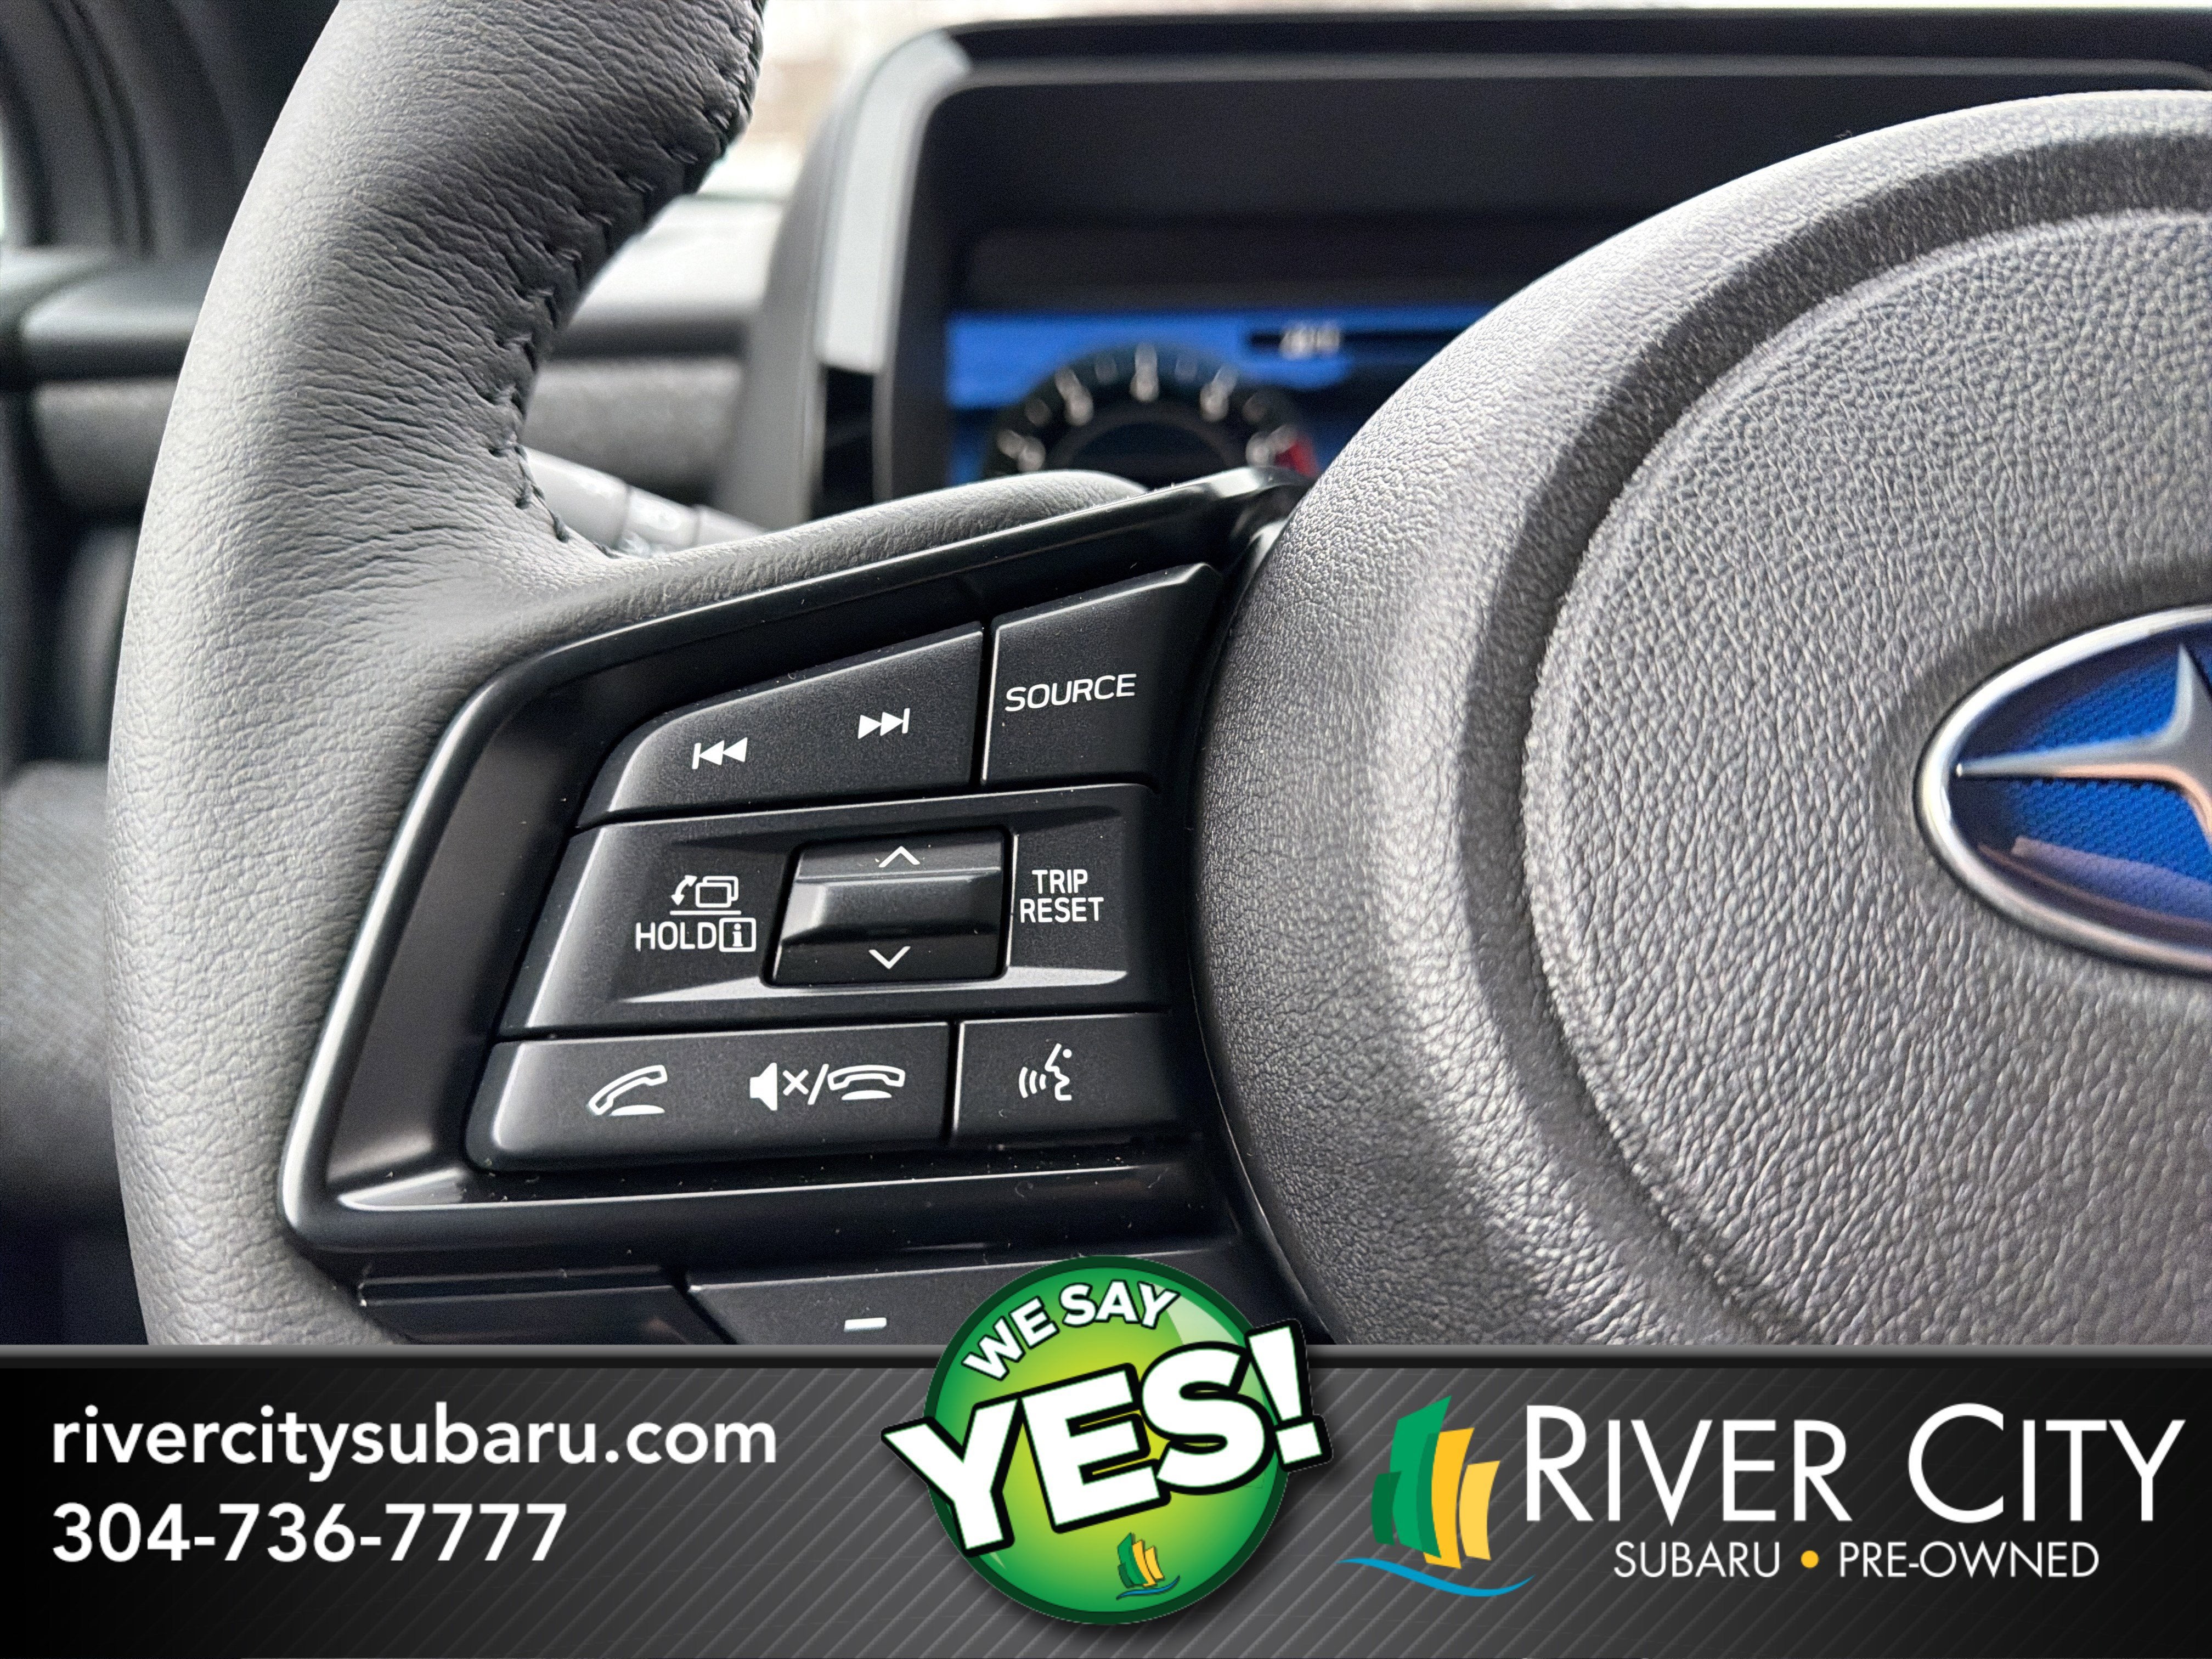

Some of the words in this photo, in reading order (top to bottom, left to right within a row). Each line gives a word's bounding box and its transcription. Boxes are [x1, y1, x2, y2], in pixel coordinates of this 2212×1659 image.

[1005, 673, 1137, 712] SOURCE
[1031, 869, 1088, 894] TRIP
[1020, 896, 1104, 923] RESET
[635, 921, 717, 952] HOLD
